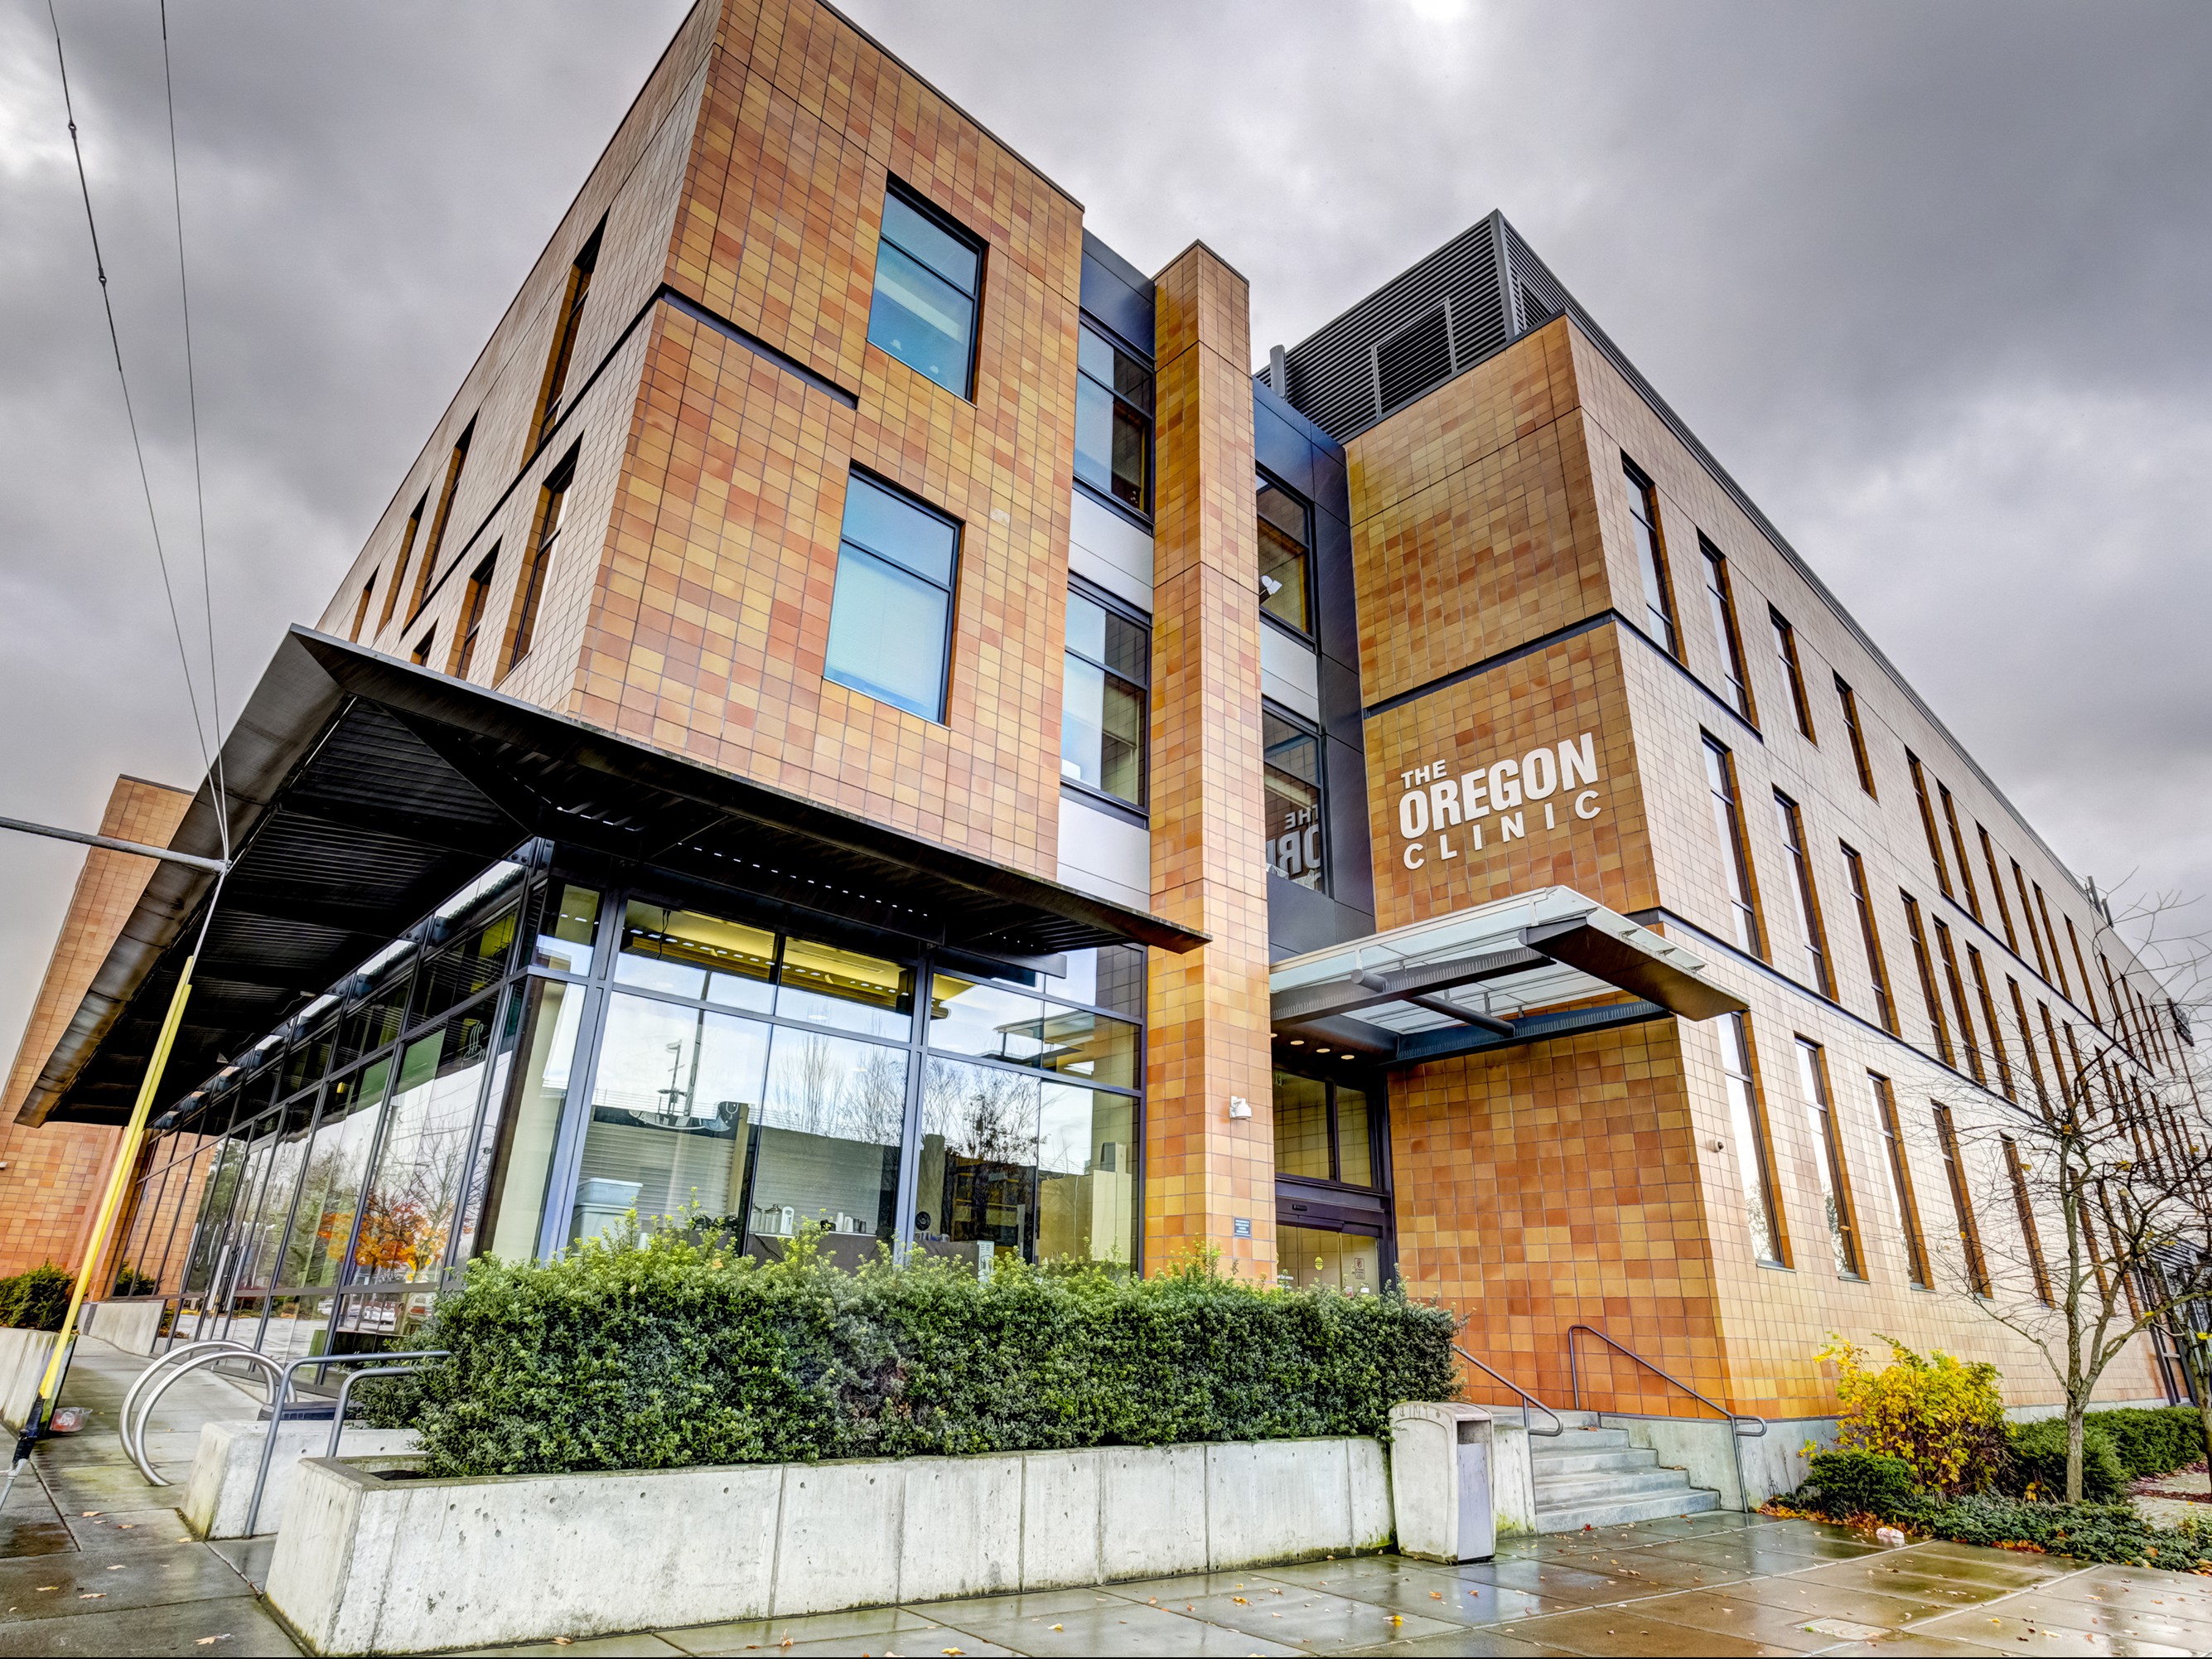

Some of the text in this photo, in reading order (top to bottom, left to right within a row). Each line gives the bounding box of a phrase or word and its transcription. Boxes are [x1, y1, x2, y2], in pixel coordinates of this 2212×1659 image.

[1398, 732, 1598, 839] OREGON
[1401, 759, 1447, 789] THE
[1403, 790, 1601, 870] CLINIC
